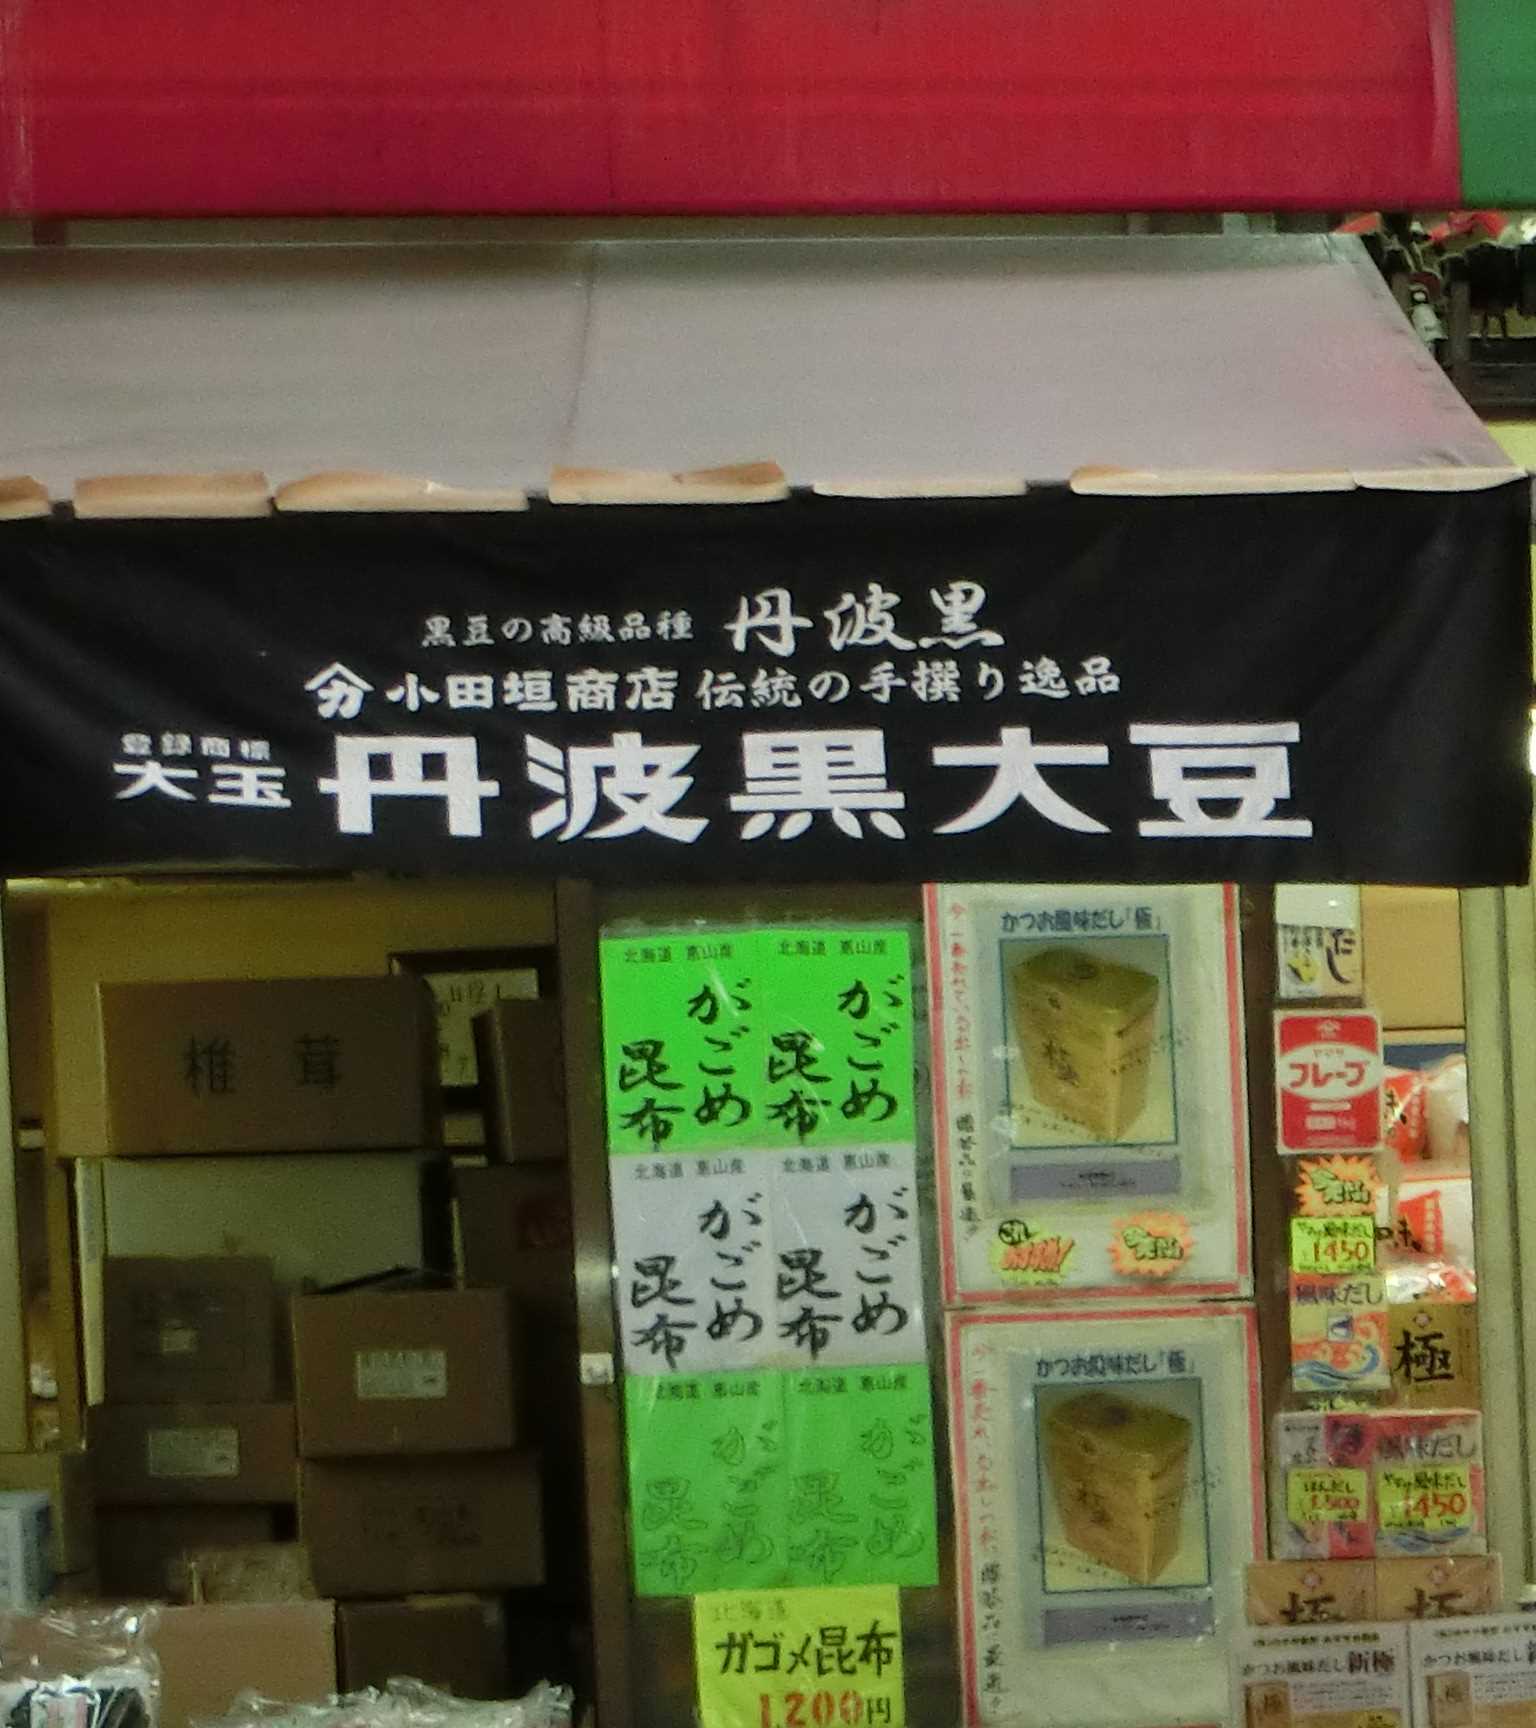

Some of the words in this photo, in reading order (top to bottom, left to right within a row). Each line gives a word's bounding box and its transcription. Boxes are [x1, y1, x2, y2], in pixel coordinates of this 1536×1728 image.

[420, 611, 695, 648] 黒豆の高級品種
[722, 580, 1005, 658] 丹波黒
[393, 668, 678, 712] 小田垣商店
[112, 759, 292, 810] 大玉
[317, 722, 1314, 843] 丹波黒大豆
[617, 1038, 686, 1152] 昆布
[687, 976, 753, 1128] がごめ
[765, 1029, 834, 1149] 昆布
[837, 973, 906, 1124] がごめ
[630, 1254, 698, 1371] 昆布
[698, 1191, 764, 1342] がごめ
[774, 1247, 843, 1361] 昆布
[842, 1185, 909, 1336] がごめ
[1395, 1330, 1455, 1384] 極
[713, 1618, 899, 1678] ガゴメ昆布
